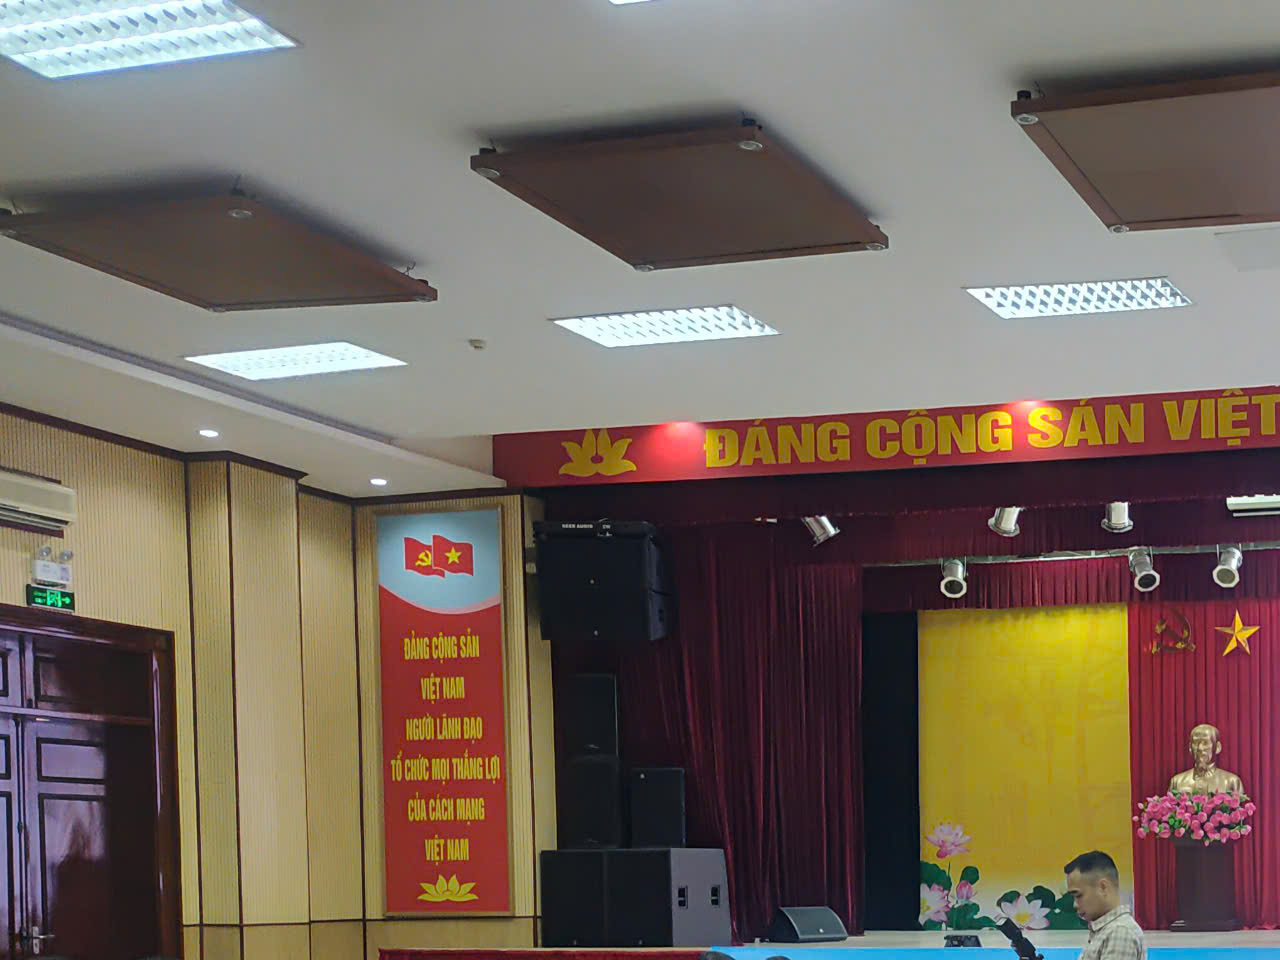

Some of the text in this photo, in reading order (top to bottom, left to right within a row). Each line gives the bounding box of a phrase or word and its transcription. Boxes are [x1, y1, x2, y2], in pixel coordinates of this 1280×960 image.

[866, 408, 1013, 466] CỘNG
[403, 627, 480, 664] ĐẢNG CỘNG SẢN
[421, 672, 465, 704] VIỆT NAM
[463, 716, 483, 744] ĐẠO
[405, 753, 429, 781] CHỨC
[431, 757, 450, 785] MỌI
[408, 791, 485, 825] CỦA CÁCH MẠNG
[424, 834, 470, 866] VIỆT NAM
